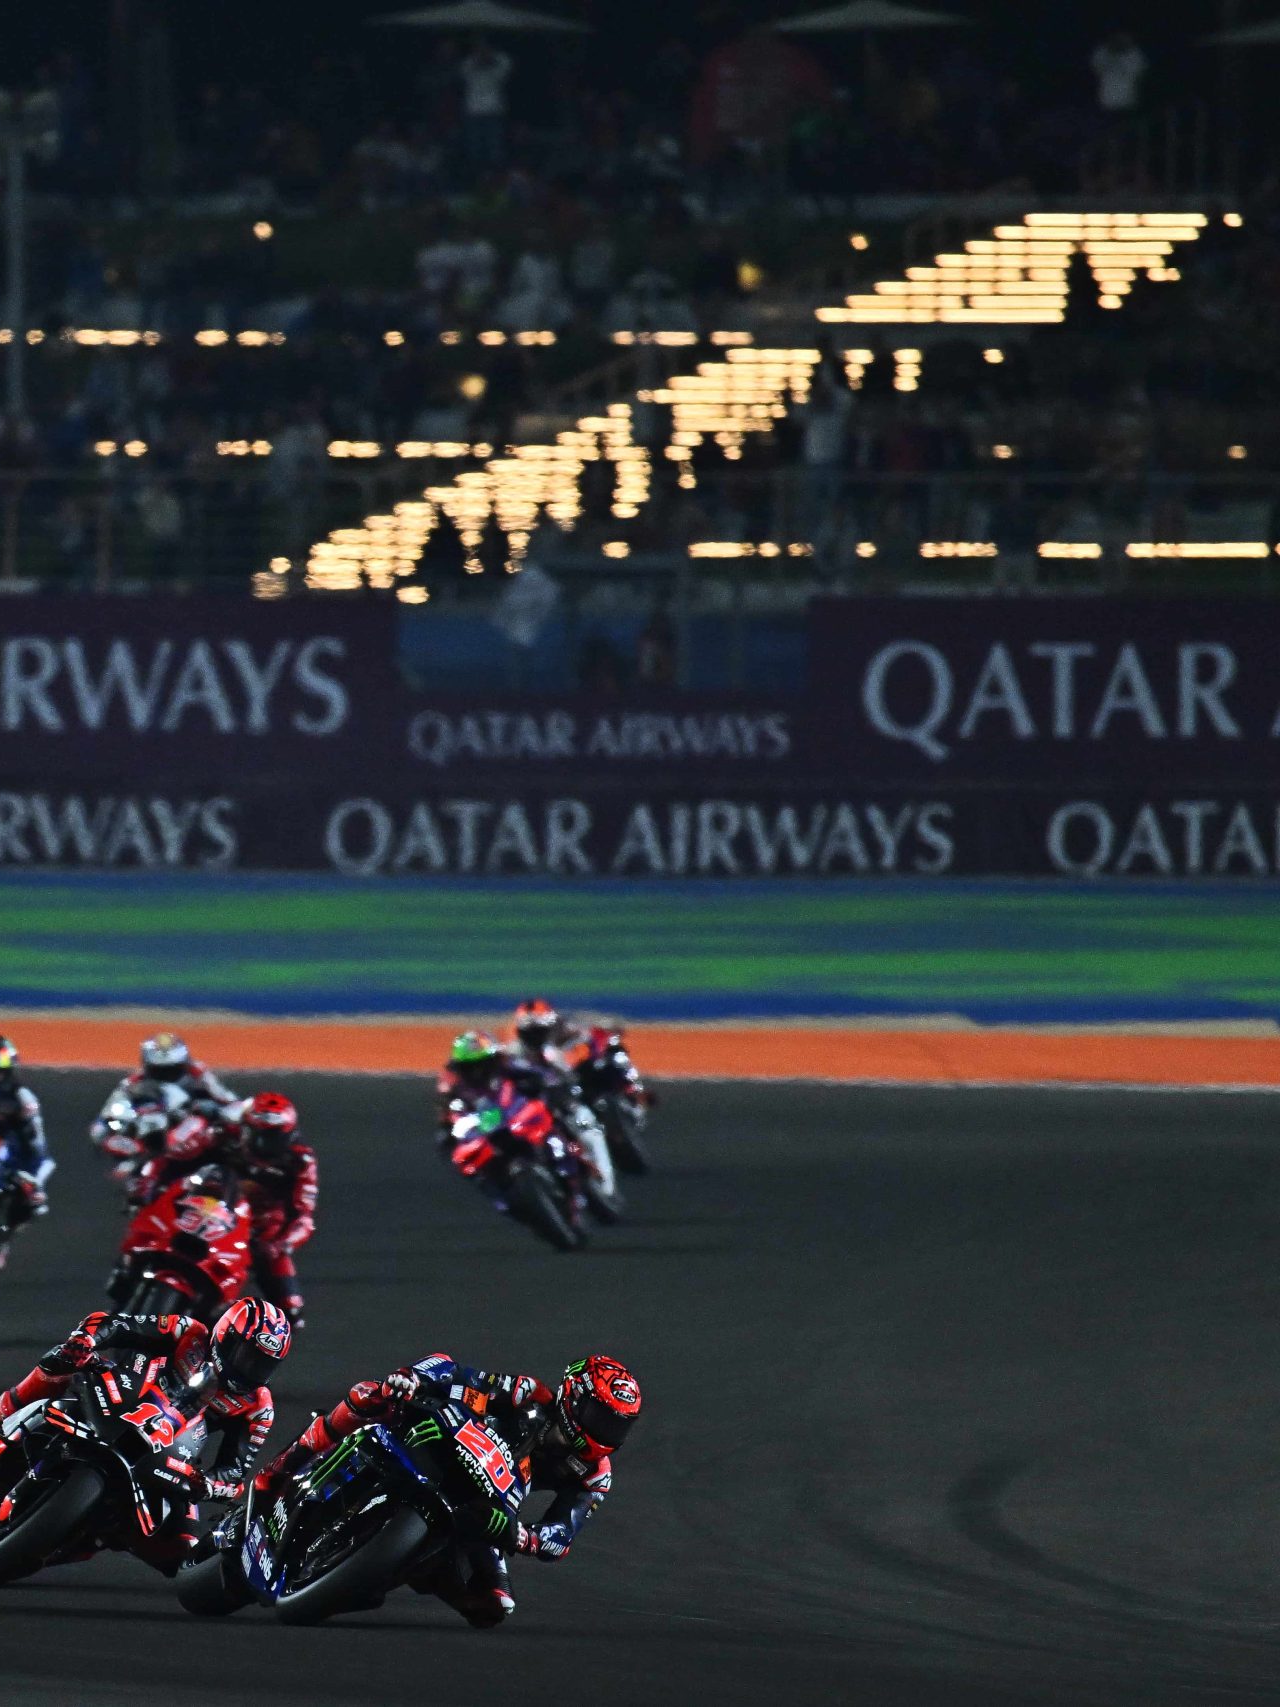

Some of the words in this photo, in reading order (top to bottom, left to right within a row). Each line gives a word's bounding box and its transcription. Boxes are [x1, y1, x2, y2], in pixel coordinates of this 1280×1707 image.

[860, 640, 1240, 760] QATAR
[407, 710, 576, 765] QATAR
[586, 711, 791, 759] AIRWAYS
[322, 798, 593, 876] QATAR
[614, 800, 954, 873] AIRWAYS
[1045, 800, 1280, 876] QATA
[259, 1334, 282, 1350] Arai
[119, 1403, 174, 1453] 12
[454, 1419, 516, 1493] 20
[484, 1427, 515, 1471] ENEOS
